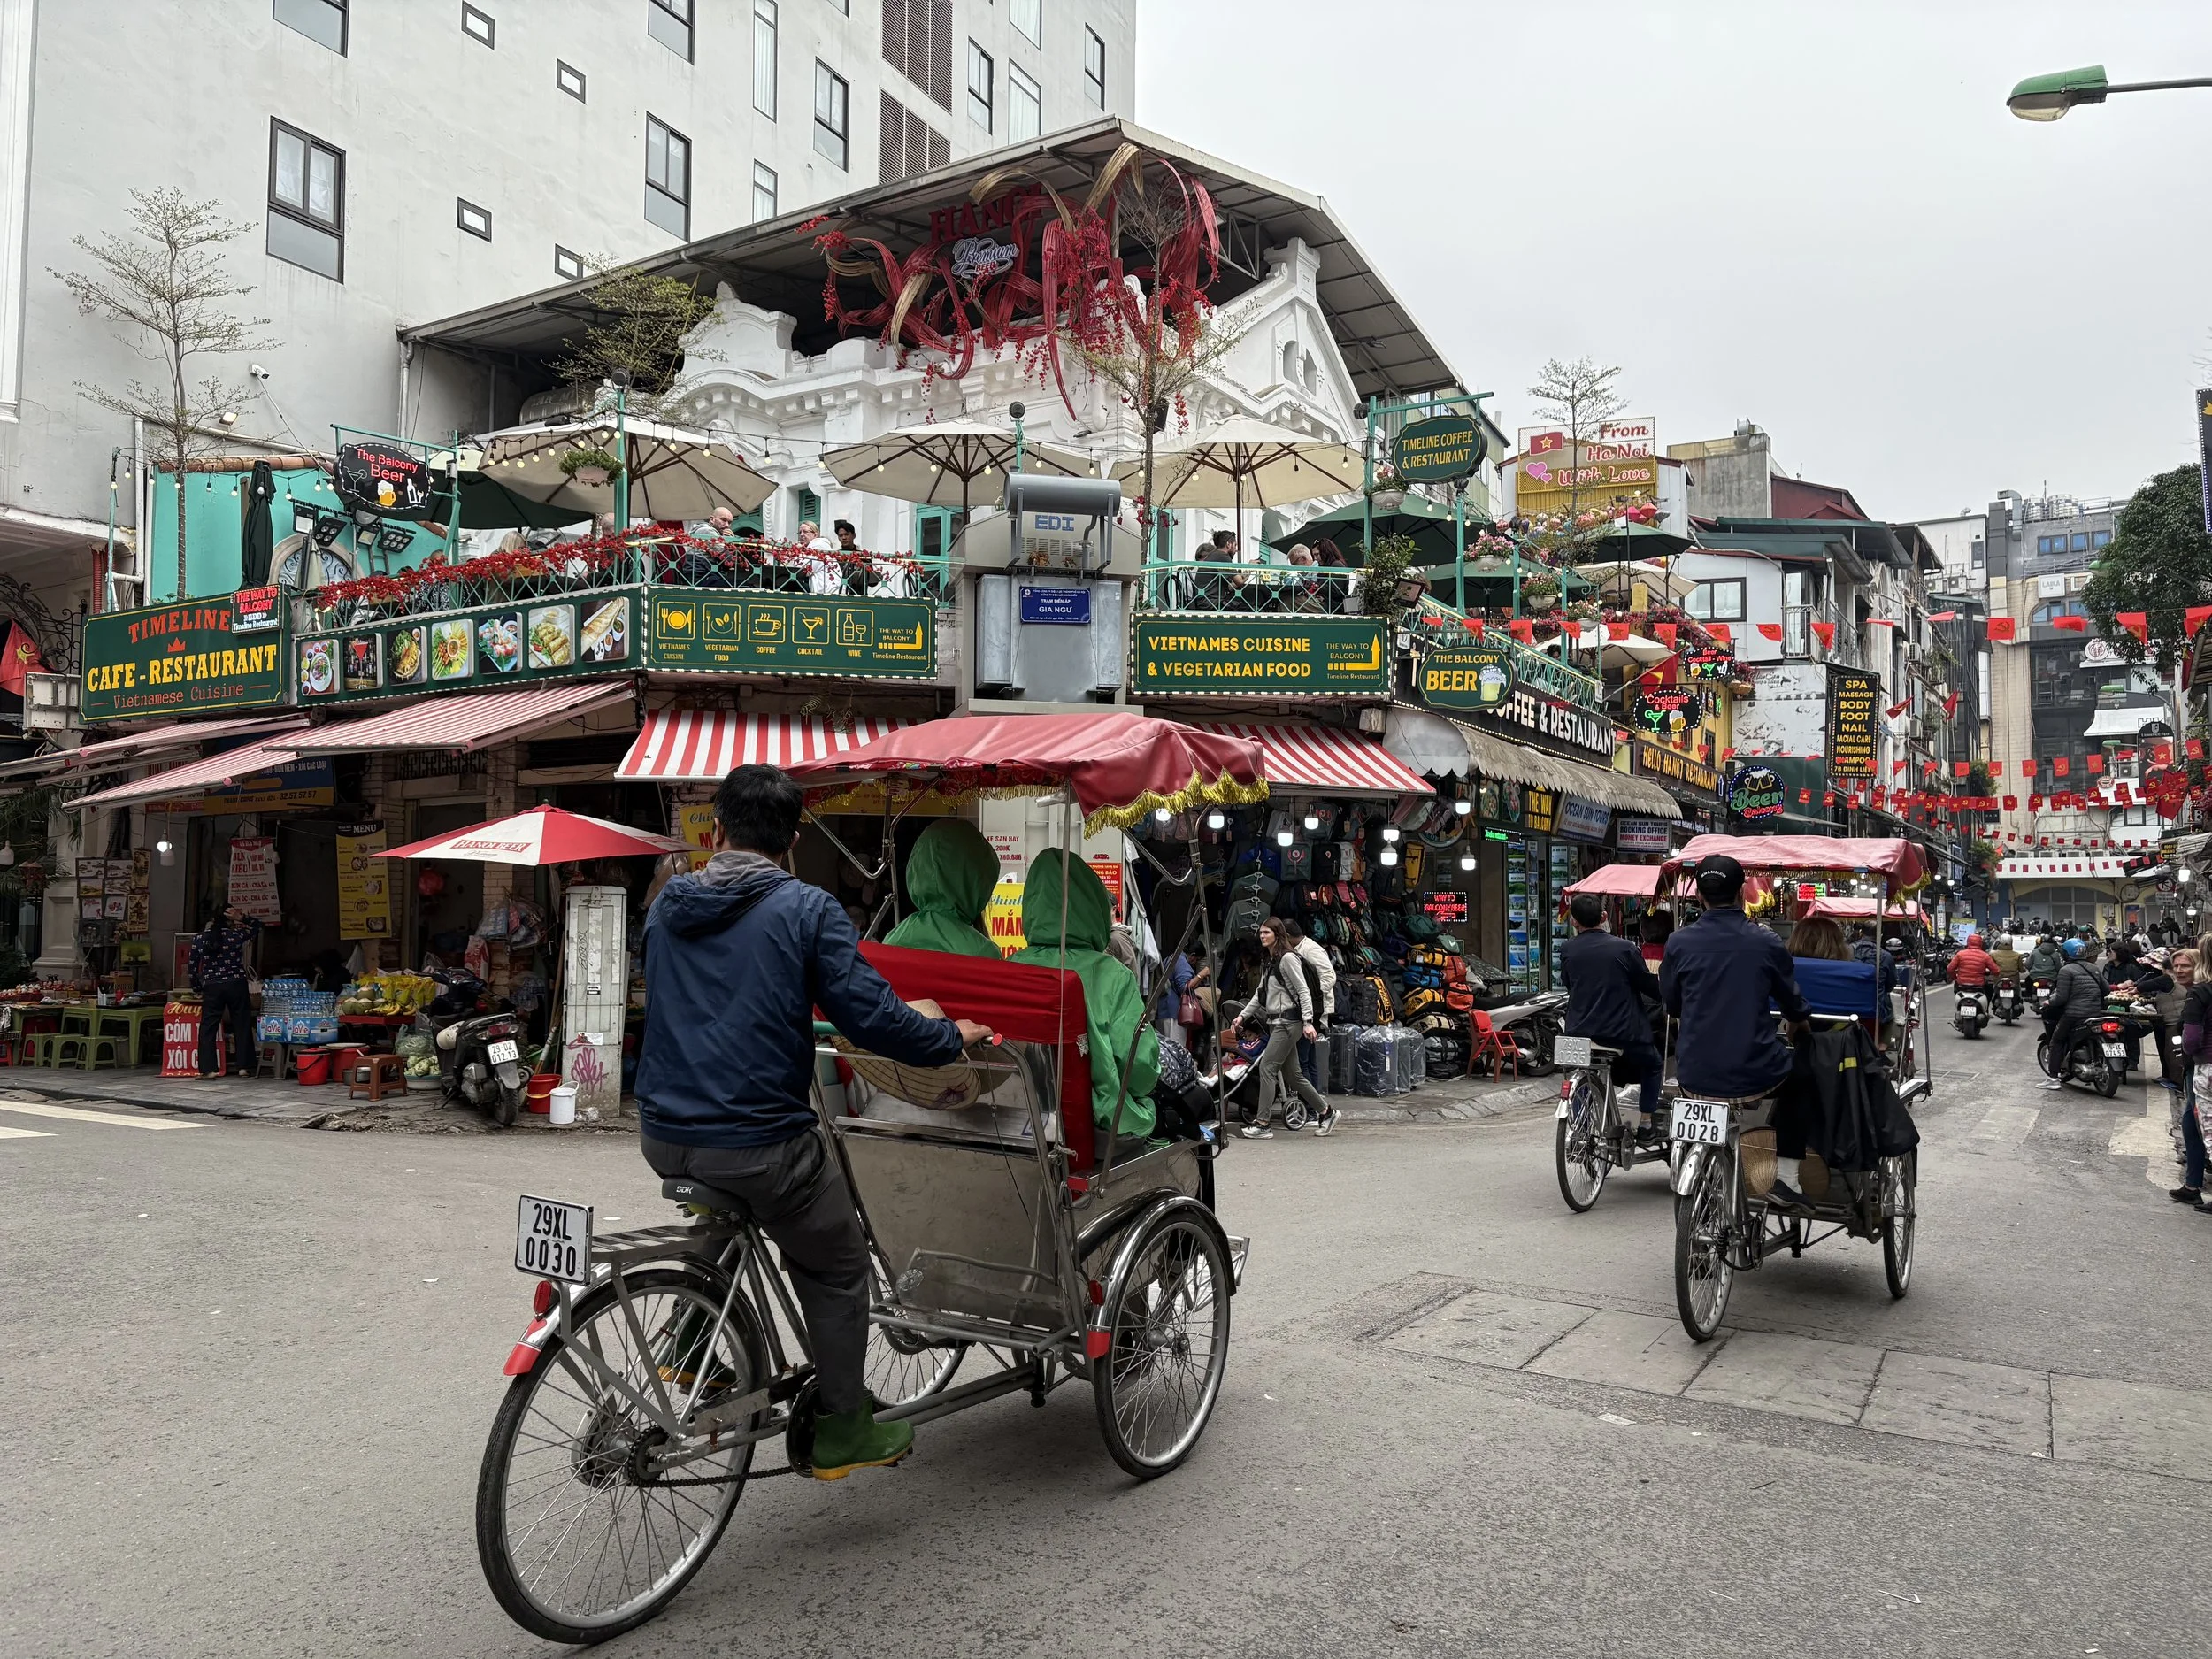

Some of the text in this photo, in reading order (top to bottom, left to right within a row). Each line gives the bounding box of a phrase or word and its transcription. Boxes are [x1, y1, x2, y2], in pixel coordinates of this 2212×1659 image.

[1600, 422, 1649, 440] From
[1402, 430, 1473, 452] TIMELINE COFFEE
[356, 448, 375, 463] The
[1402, 449, 1470, 470] & RESTAURANT
[1586, 442, 1649, 461] Ha Noi
[370, 463, 405, 483] Beer
[1609, 465, 1651, 483] Love
[1034, 514, 1075, 531] EDI
[236, 587, 278, 603] THE WAY TO
[240, 599, 273, 613] BALCONY
[128, 609, 232, 644] TIMELINE
[1149, 636, 1310, 652] VIETNAMES CUISINE
[87, 663, 136, 692] CAFE
[149, 644, 277, 685] RESTAURANT
[1434, 655, 1500, 664] THE BALCONY
[1147, 661, 1311, 677] & VEGETARIAN FOOD
[1425, 670, 1479, 692] BEER
[1845, 680, 1868, 689] SPA
[113, 683, 244, 709] Vietnamese Cuisine
[1647, 695, 1689, 704] Cocktails
[1839, 701, 1870, 710] BODY
[1486, 691, 1617, 757] FFEE & RESTAURANT
[1841, 723, 1867, 732] NAIL
[1836, 734, 1855, 743] FACIAL
[1836, 745, 1870, 754] NOURISHING
[1836, 756, 1870, 764] AMPOO
[1731, 787, 1784, 810] Beer
[1565, 801, 1609, 825] OCEAN SUN TOURS
[354, 824, 377, 833] MENU
[456, 839, 495, 849] HANOI
[167, 1046, 188, 1070] XÔI
[1684, 1103, 1715, 1123] 29XL
[1677, 1121, 1718, 1142] 0028
[533, 1203, 572, 1240] 29XL
[526, 1236, 576, 1277] 0030
